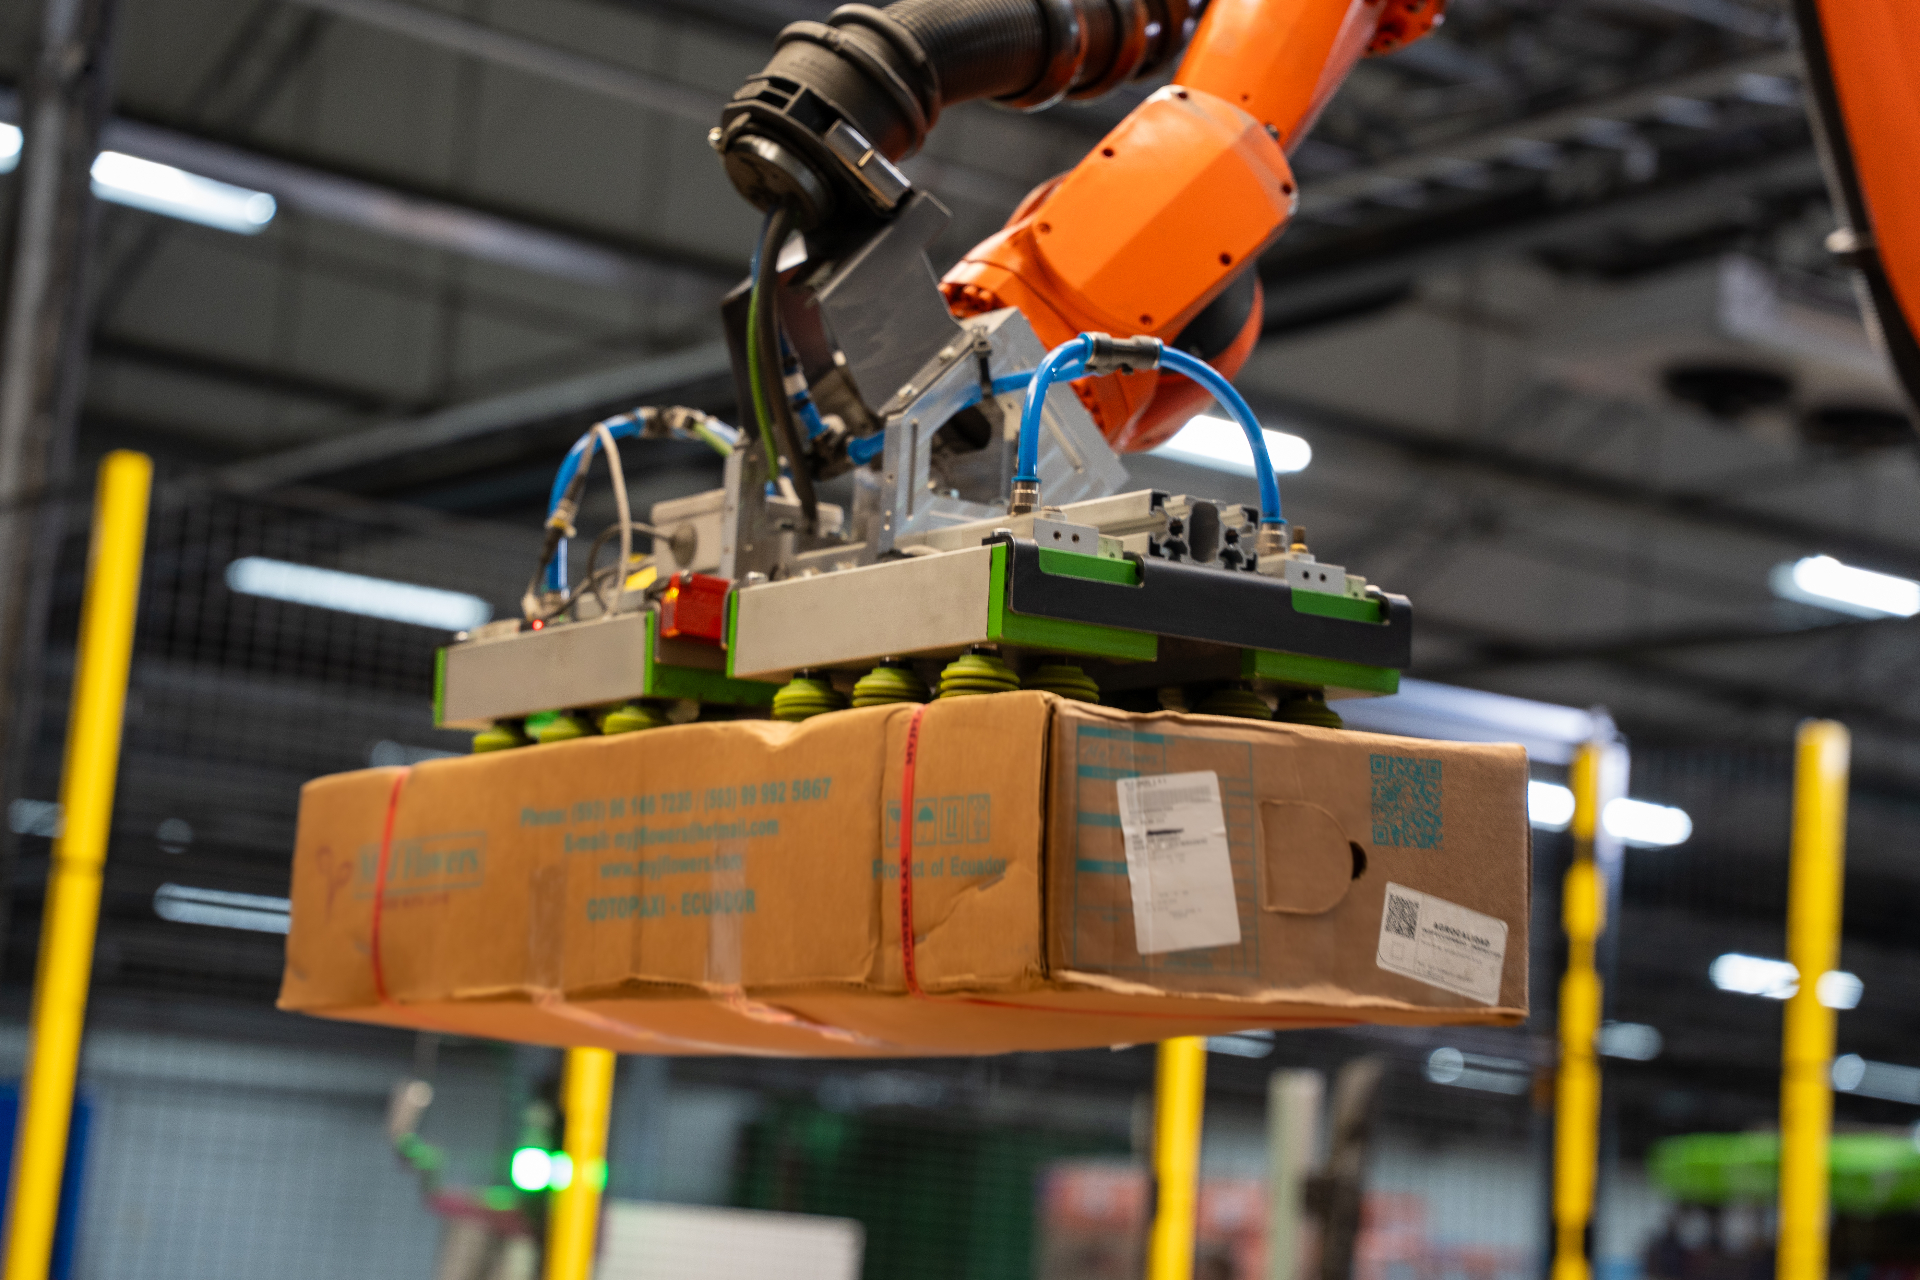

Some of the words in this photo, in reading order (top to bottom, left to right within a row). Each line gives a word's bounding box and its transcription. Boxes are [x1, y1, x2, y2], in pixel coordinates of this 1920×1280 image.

[660, 790, 692, 814] 7235
[703, 786, 737, 815] (593)
[741, 784, 757, 806] 99
[761, 781, 787, 804] 992
[791, 777, 832, 801] 5867
[872, 857, 924, 880] Proct
[931, 856, 945, 878] of
[950, 854, 1008, 877] Ecuador
[586, 893, 666, 922] COTOPAXI
[681, 889, 756, 916] ECUADOR
